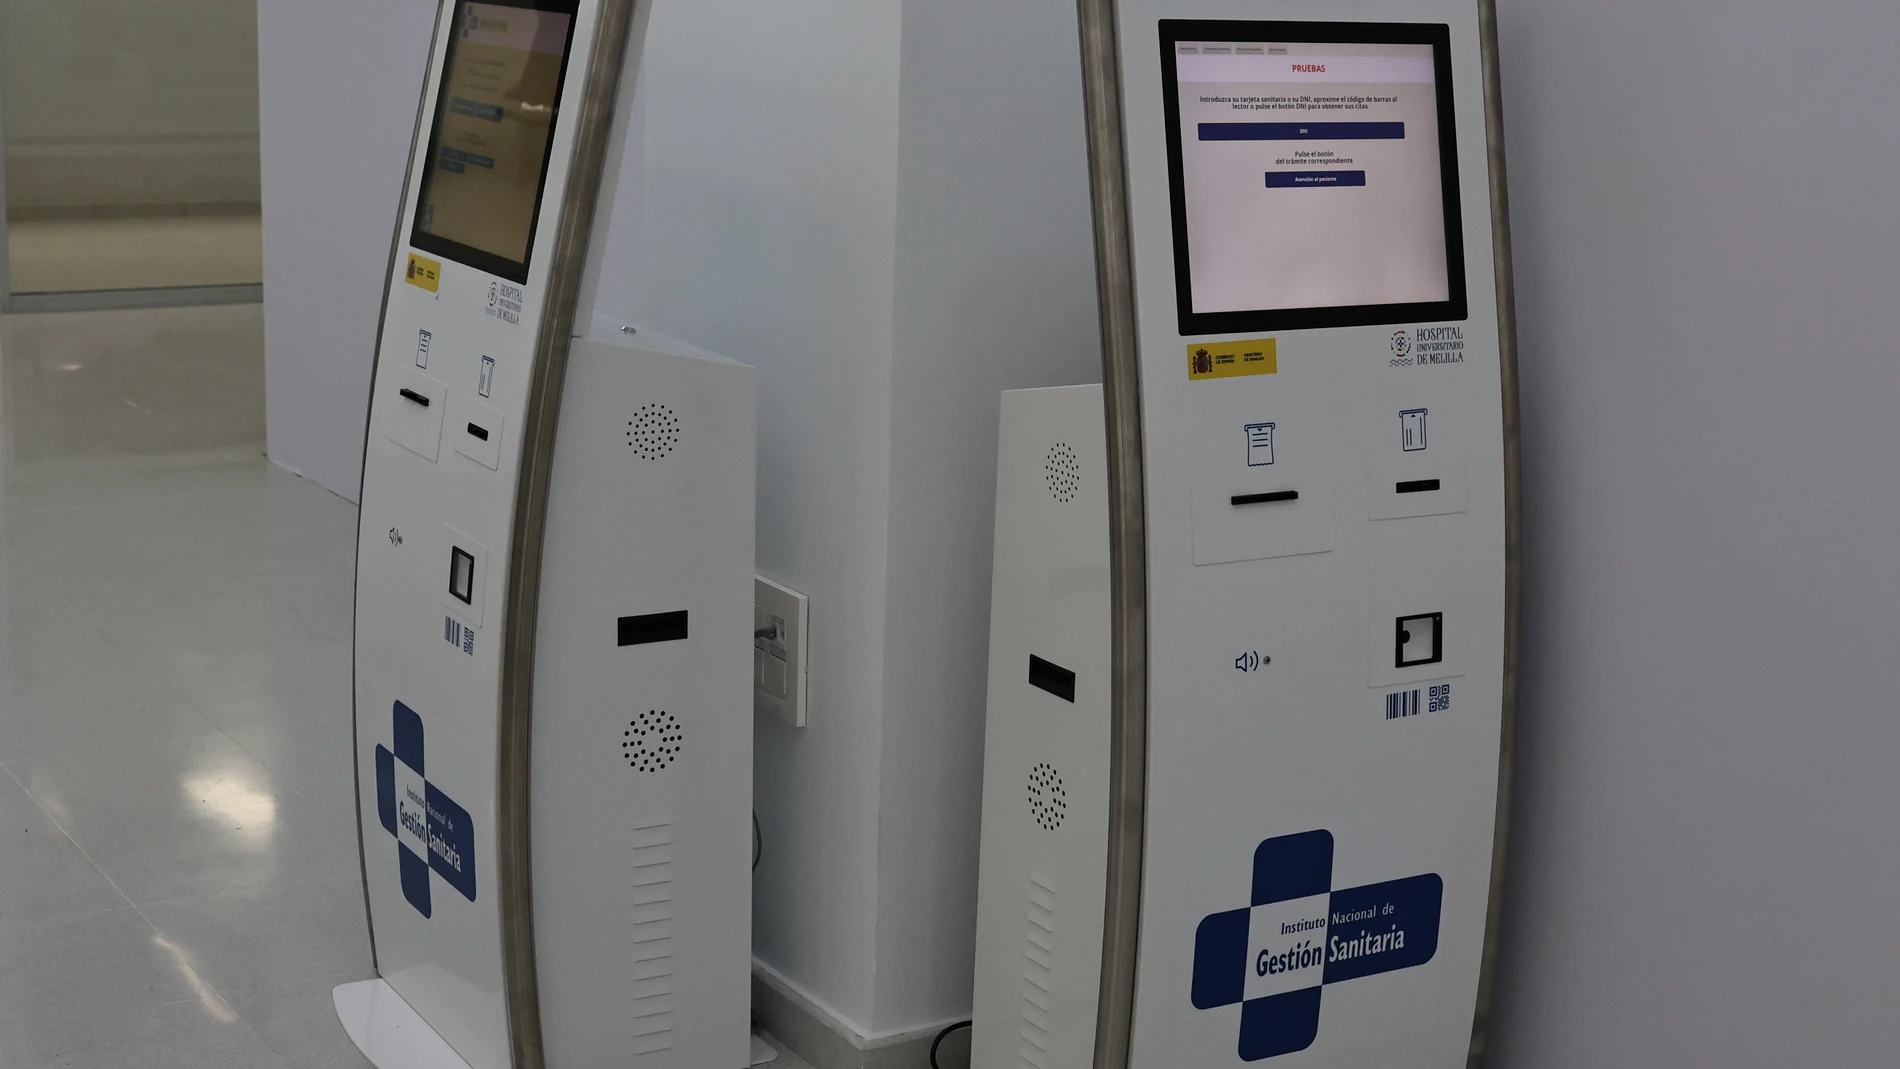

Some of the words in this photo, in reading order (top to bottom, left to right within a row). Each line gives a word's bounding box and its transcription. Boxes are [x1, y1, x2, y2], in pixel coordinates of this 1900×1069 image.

[1292, 64, 1326, 73] PRUEBAS
[1240, 96, 1260, 104] tarjeta
[1313, 96, 1339, 104] aproxime
[1346, 96, 1364, 104] código
[1255, 103, 1271, 111] pulse
[1308, 157, 1353, 165] correspondiente
[500, 283, 523, 303] HOSPITAL
[1416, 327, 1463, 341] HOSPITAL
[1417, 341, 1464, 352] UNIVERSITARIO
[1417, 354, 1428, 365] DE
[1429, 352, 1464, 364] MELILLA
[407, 785, 425, 809] Instituto
[426, 801, 446, 826] Nacional
[447, 818, 454, 832] de
[400, 800, 426, 844] Gestión
[427, 823, 461, 873] Sanitaria
[1281, 917, 1326, 935] Instituto
[1332, 905, 1376, 925] Nacional
[1382, 903, 1395, 915] de
[1256, 940, 1322, 977] Gestión
[1329, 924, 1405, 962] Sanitaria
